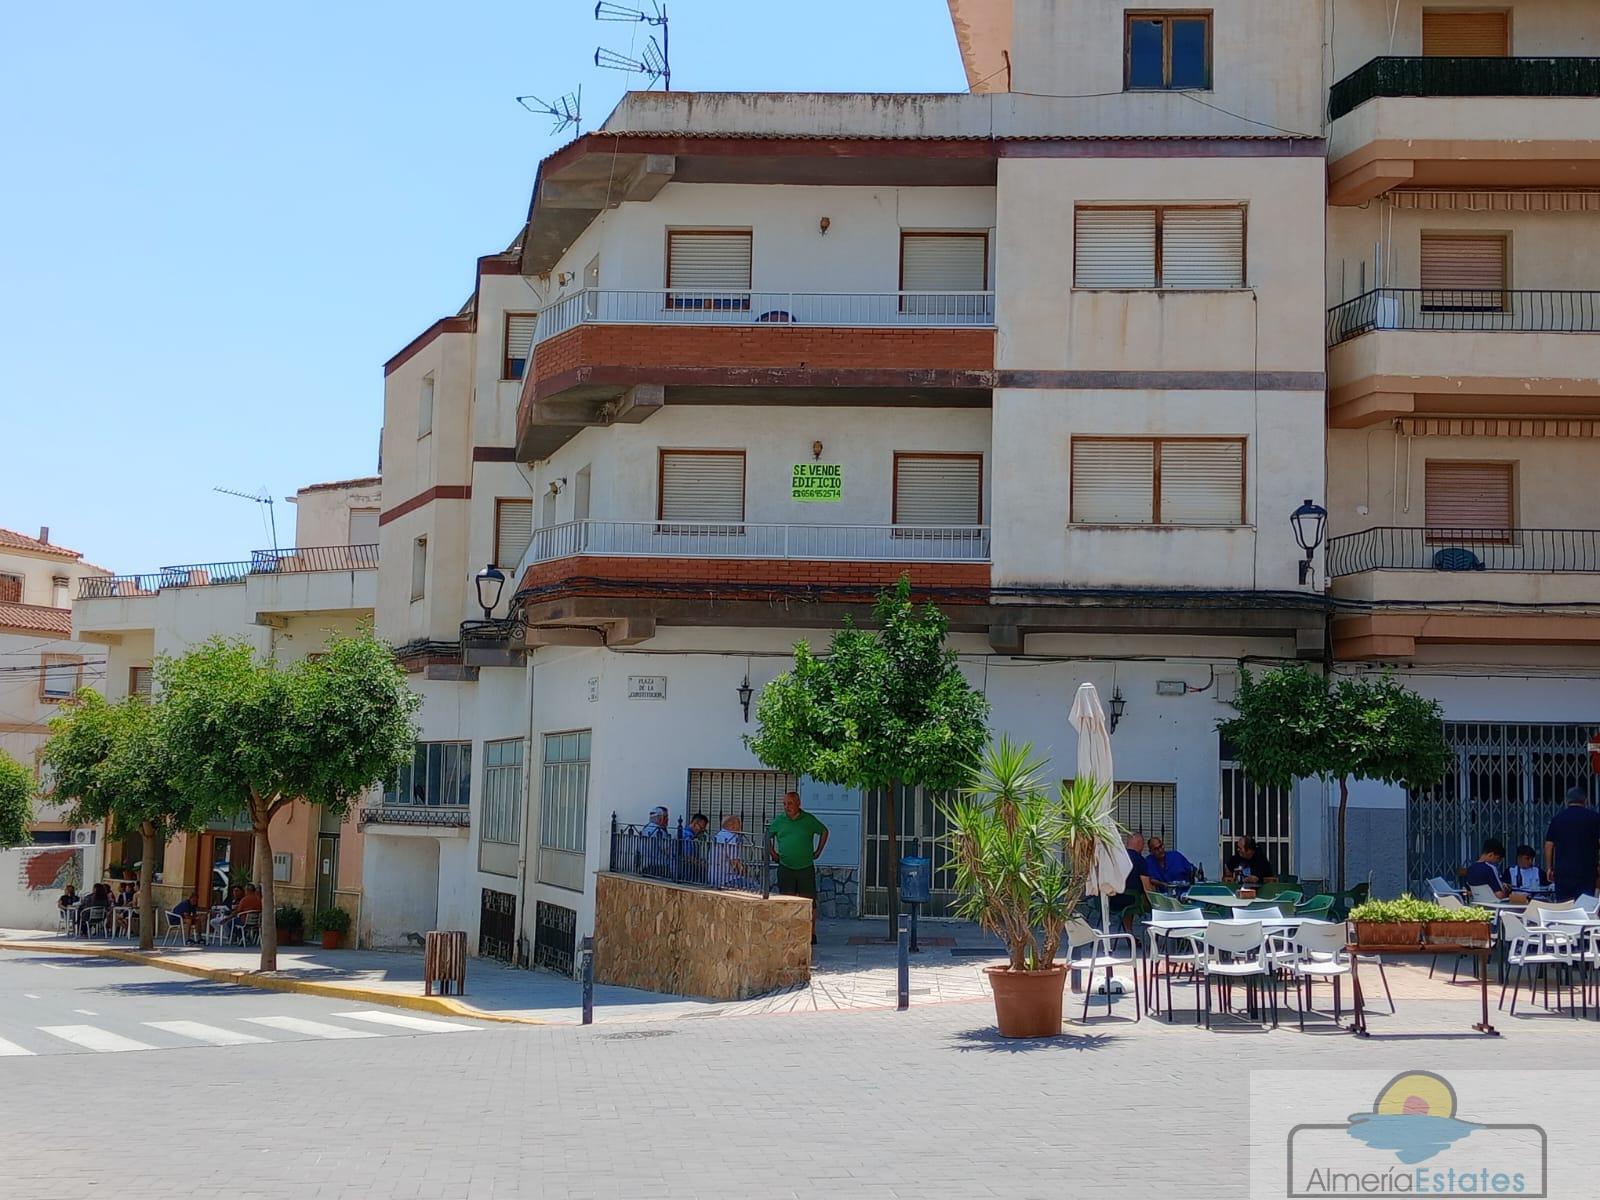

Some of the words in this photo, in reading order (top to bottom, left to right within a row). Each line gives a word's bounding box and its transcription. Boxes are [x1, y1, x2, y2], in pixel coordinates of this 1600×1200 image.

[793, 464, 806, 476] SE
[808, 464, 841, 476] VENDE
[791, 476, 842, 488] EDIFICIO
